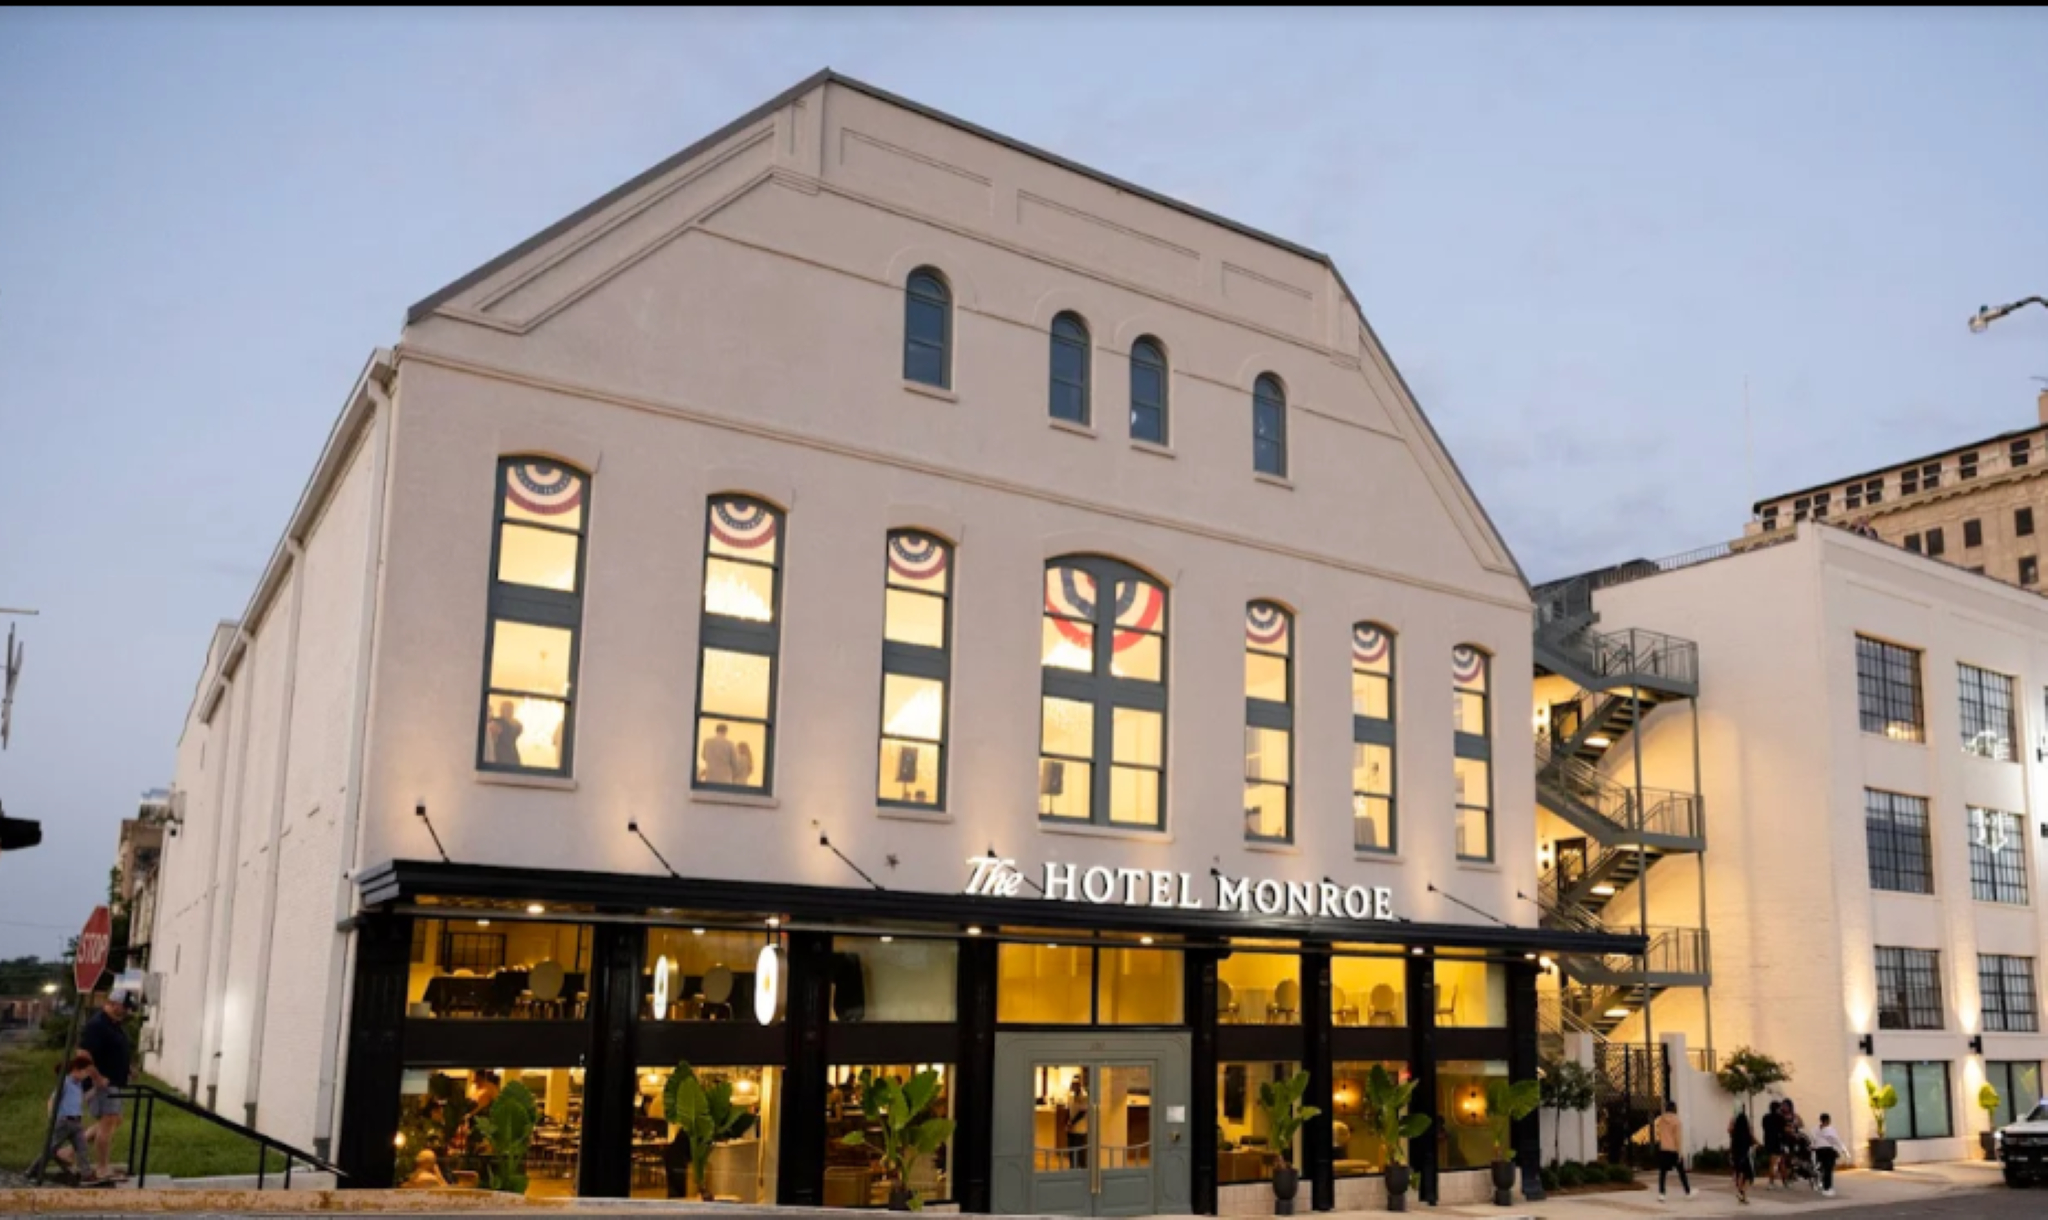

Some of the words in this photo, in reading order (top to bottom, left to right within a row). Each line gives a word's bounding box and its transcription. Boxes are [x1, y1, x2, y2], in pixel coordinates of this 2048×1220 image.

[965, 856, 1024, 896] The
[1042, 861, 1201, 909] HOTEL
[1216, 876, 1393, 921] MONROE
[78, 932, 109, 964] STOP
